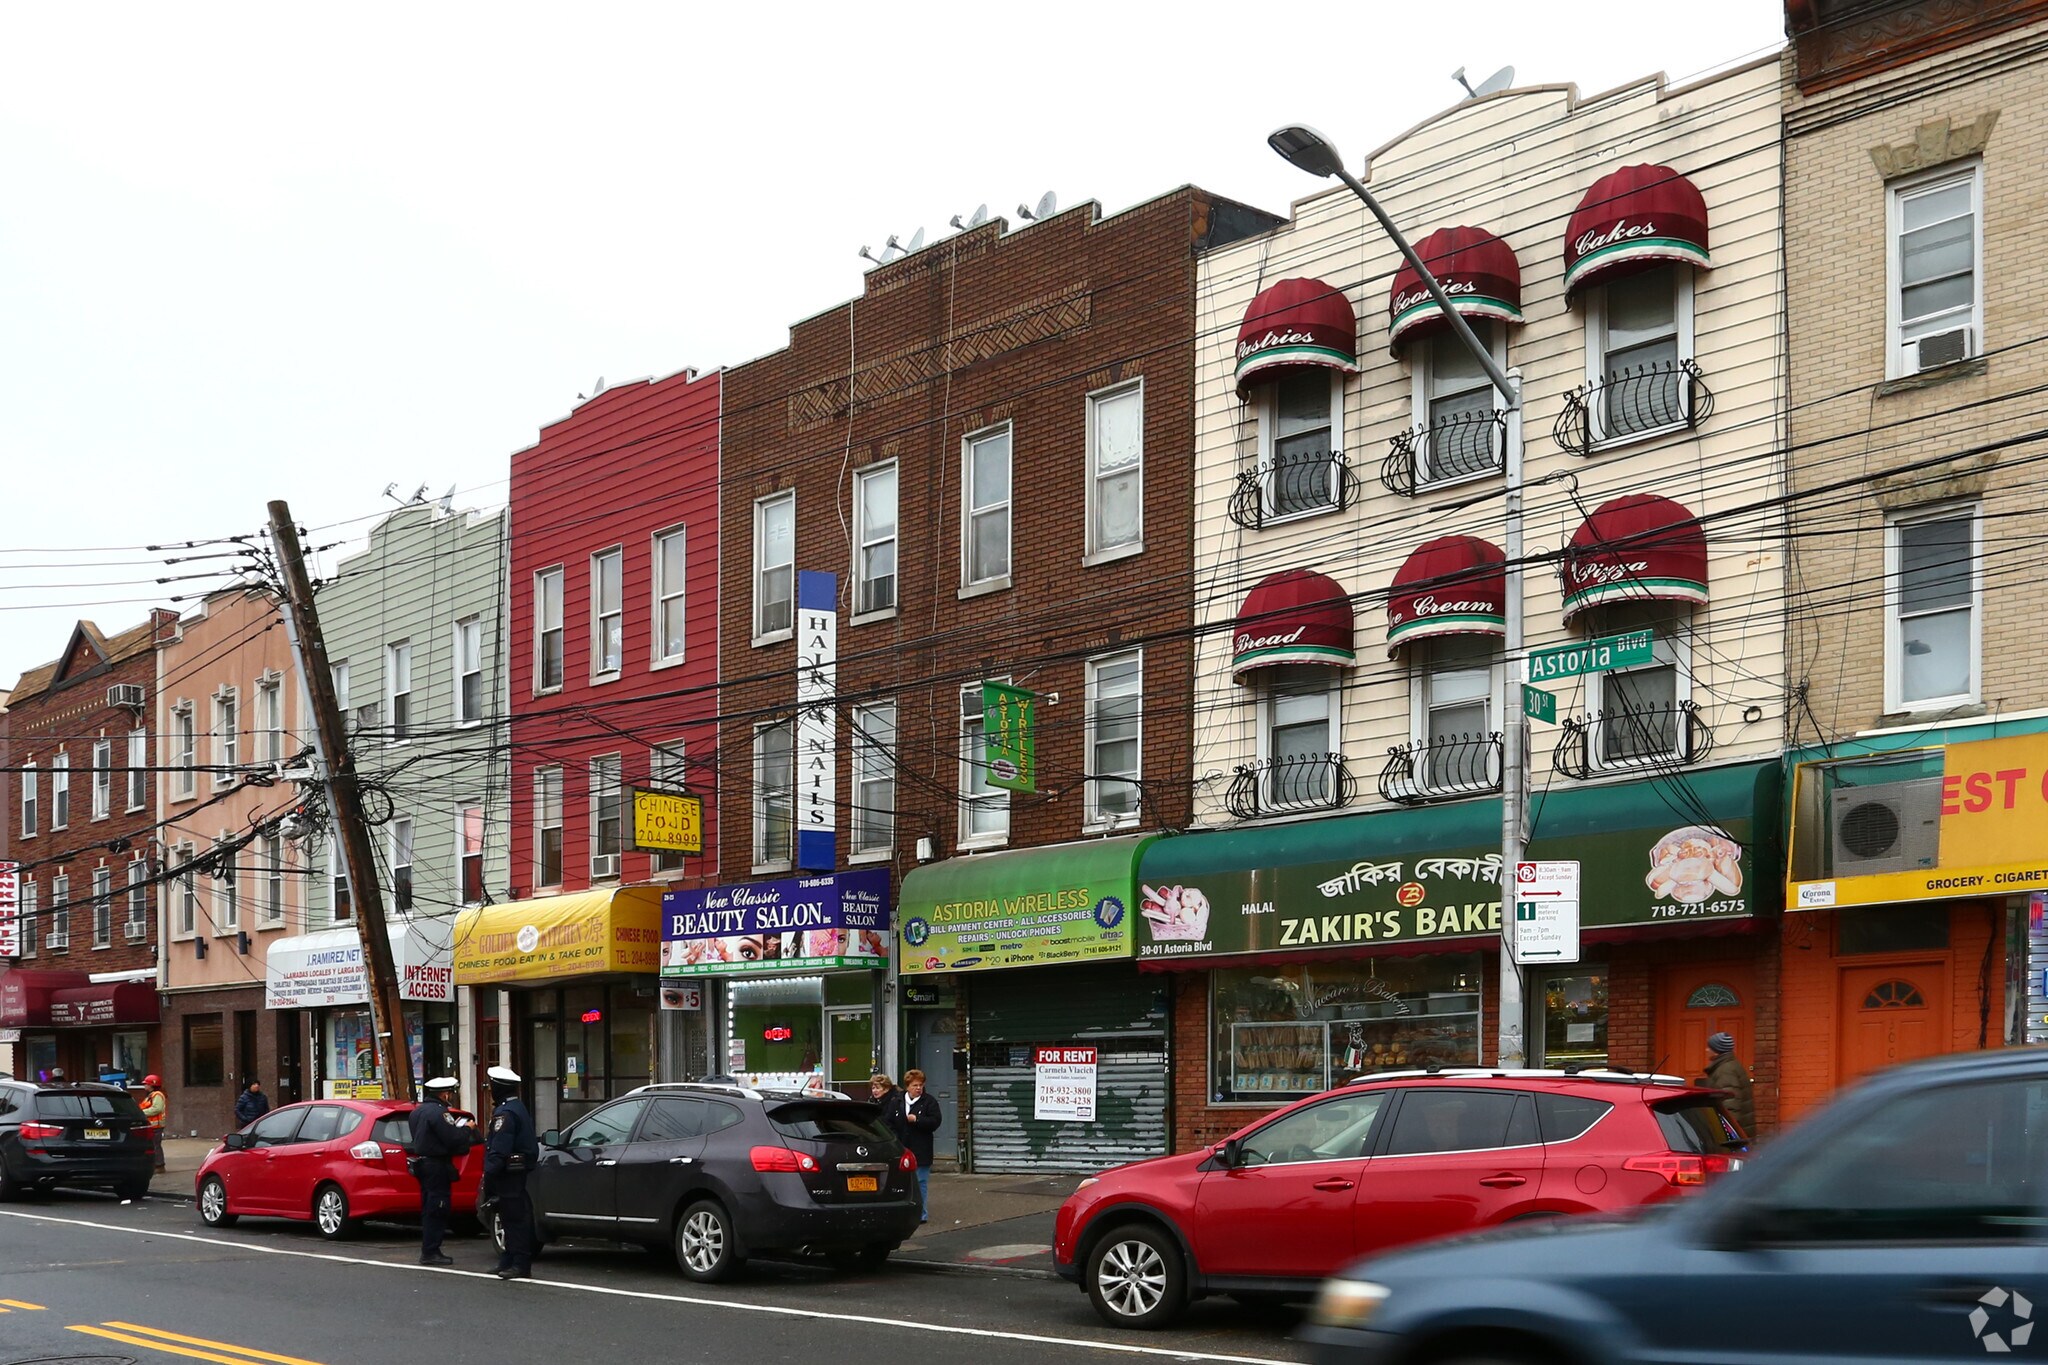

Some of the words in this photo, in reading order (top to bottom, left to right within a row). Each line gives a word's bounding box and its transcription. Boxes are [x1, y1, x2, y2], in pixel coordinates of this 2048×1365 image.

[1575, 219, 1656, 255] Cakes
[1237, 328, 1314, 360] Pastries
[1574, 559, 1648, 583] Pizza
[1413, 595, 1494, 616] Cream
[1234, 625, 1306, 655] Bread
[808, 616, 828, 685] HAIR
[1532, 642, 1610, 678] Astoria
[1616, 632, 1647, 652] Blvd
[1528, 690, 1541, 714] 30
[1543, 693, 1548, 708] St
[998, 693, 1009, 756] ASTORIA
[809, 738, 827, 824] NAILS
[639, 797, 697, 817] CHINESE
[1316, 861, 1404, 898] জাকির
[1926, 876, 1984, 890] GROCERY
[697, 890, 728, 909] New
[731, 887, 780, 906] Classic
[841, 890, 858, 901] New
[858, 890, 880, 901] Classic
[1802, 889, 1831, 899] Corona
[842, 902, 879, 914] BEAUTY
[932, 900, 1000, 922] ASTORIA
[1241, 902, 1275, 915] HALAL
[1523, 903, 1530, 919] 1
[1651, 899, 1745, 918] 718-721-6575
[671, 908, 747, 936] BEAUTY
[756, 902, 823, 930] SALON
[845, 915, 876, 926] SALON
[930, 926, 946, 934] BILL
[948, 922, 982, 932] PAYMENT
[984, 919, 1013, 929] CENTER
[1021, 916, 1035, 926] ALL
[1037, 910, 1092, 924] ACCESSORIES
[1279, 909, 1401, 946] ZAKIR'S
[479, 932, 515, 954] GOLDEN
[540, 922, 583, 947] KITCHEN
[615, 927, 640, 943] CHINESE
[642, 929, 658, 943] FOOD
[958, 934, 989, 943] REPAIRS
[996, 929, 1027, 939] UNLOCK
[1029, 926, 1061, 936] PHONES
[616, 949, 630, 964] TEL:
[1141, 944, 1163, 955] 30-01
[1164, 942, 1193, 954] Astoria
[1194, 941, 1212, 951] Blvd
[307, 950, 344, 966] J.RAMIREZ
[346, 949, 360, 961] NET
[458, 959, 490, 970] CHINESE
[494, 957, 516, 966] FOOD
[519, 955, 535, 965] EAT
[538, 953, 546, 962] IN
[549, 952, 555, 960] &
[559, 949, 581, 959] TAKE
[585, 946, 603, 956] OUT
[1011, 955, 1034, 963] iPhone
[309, 968, 331, 977] LOCALES
[337, 966, 354, 974] LARGA
[405, 965, 451, 983] INTERNET
[480, 969, 517, 980] DELIVERY
[408, 982, 446, 998] ACCESS
[913, 993, 935, 1002] smart
[1363, 977, 1410, 1015] Bakery
[581, 1010, 601, 1023] OPEN
[764, 1028, 792, 1040] OPEN
[1039, 1050, 1060, 1062] FOR
[1063, 1050, 1093, 1062] RENT
[1039, 1066, 1067, 1074] Carmela
[1068, 1066, 1093, 1074] Vlacich
[1040, 1086, 1091, 1095] 718-932-3800
[1040, 1096, 1091, 1105] 917-882-4238
